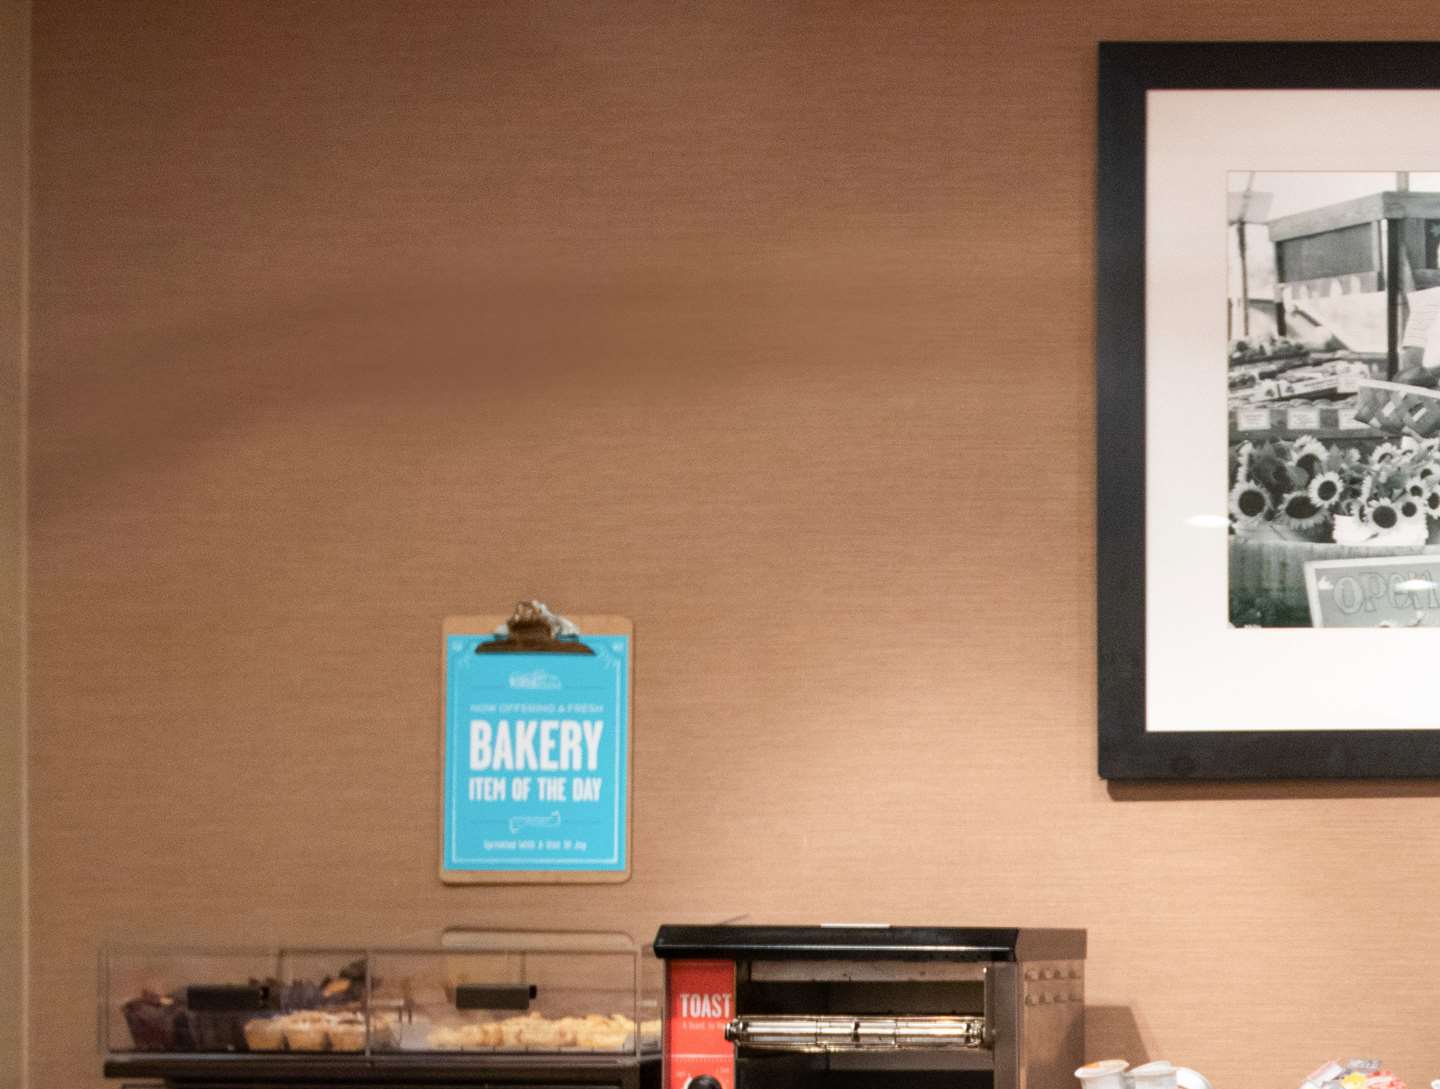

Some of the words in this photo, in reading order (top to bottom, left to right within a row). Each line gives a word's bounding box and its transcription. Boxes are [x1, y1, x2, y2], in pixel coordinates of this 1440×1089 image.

[469, 719, 603, 772] BAKERY
[468, 776, 506, 801] ITEM
[511, 776, 531, 801] OF
[537, 776, 567, 801] THE
[572, 776, 602, 801] DAY
[680, 993, 731, 1018] TOAST
